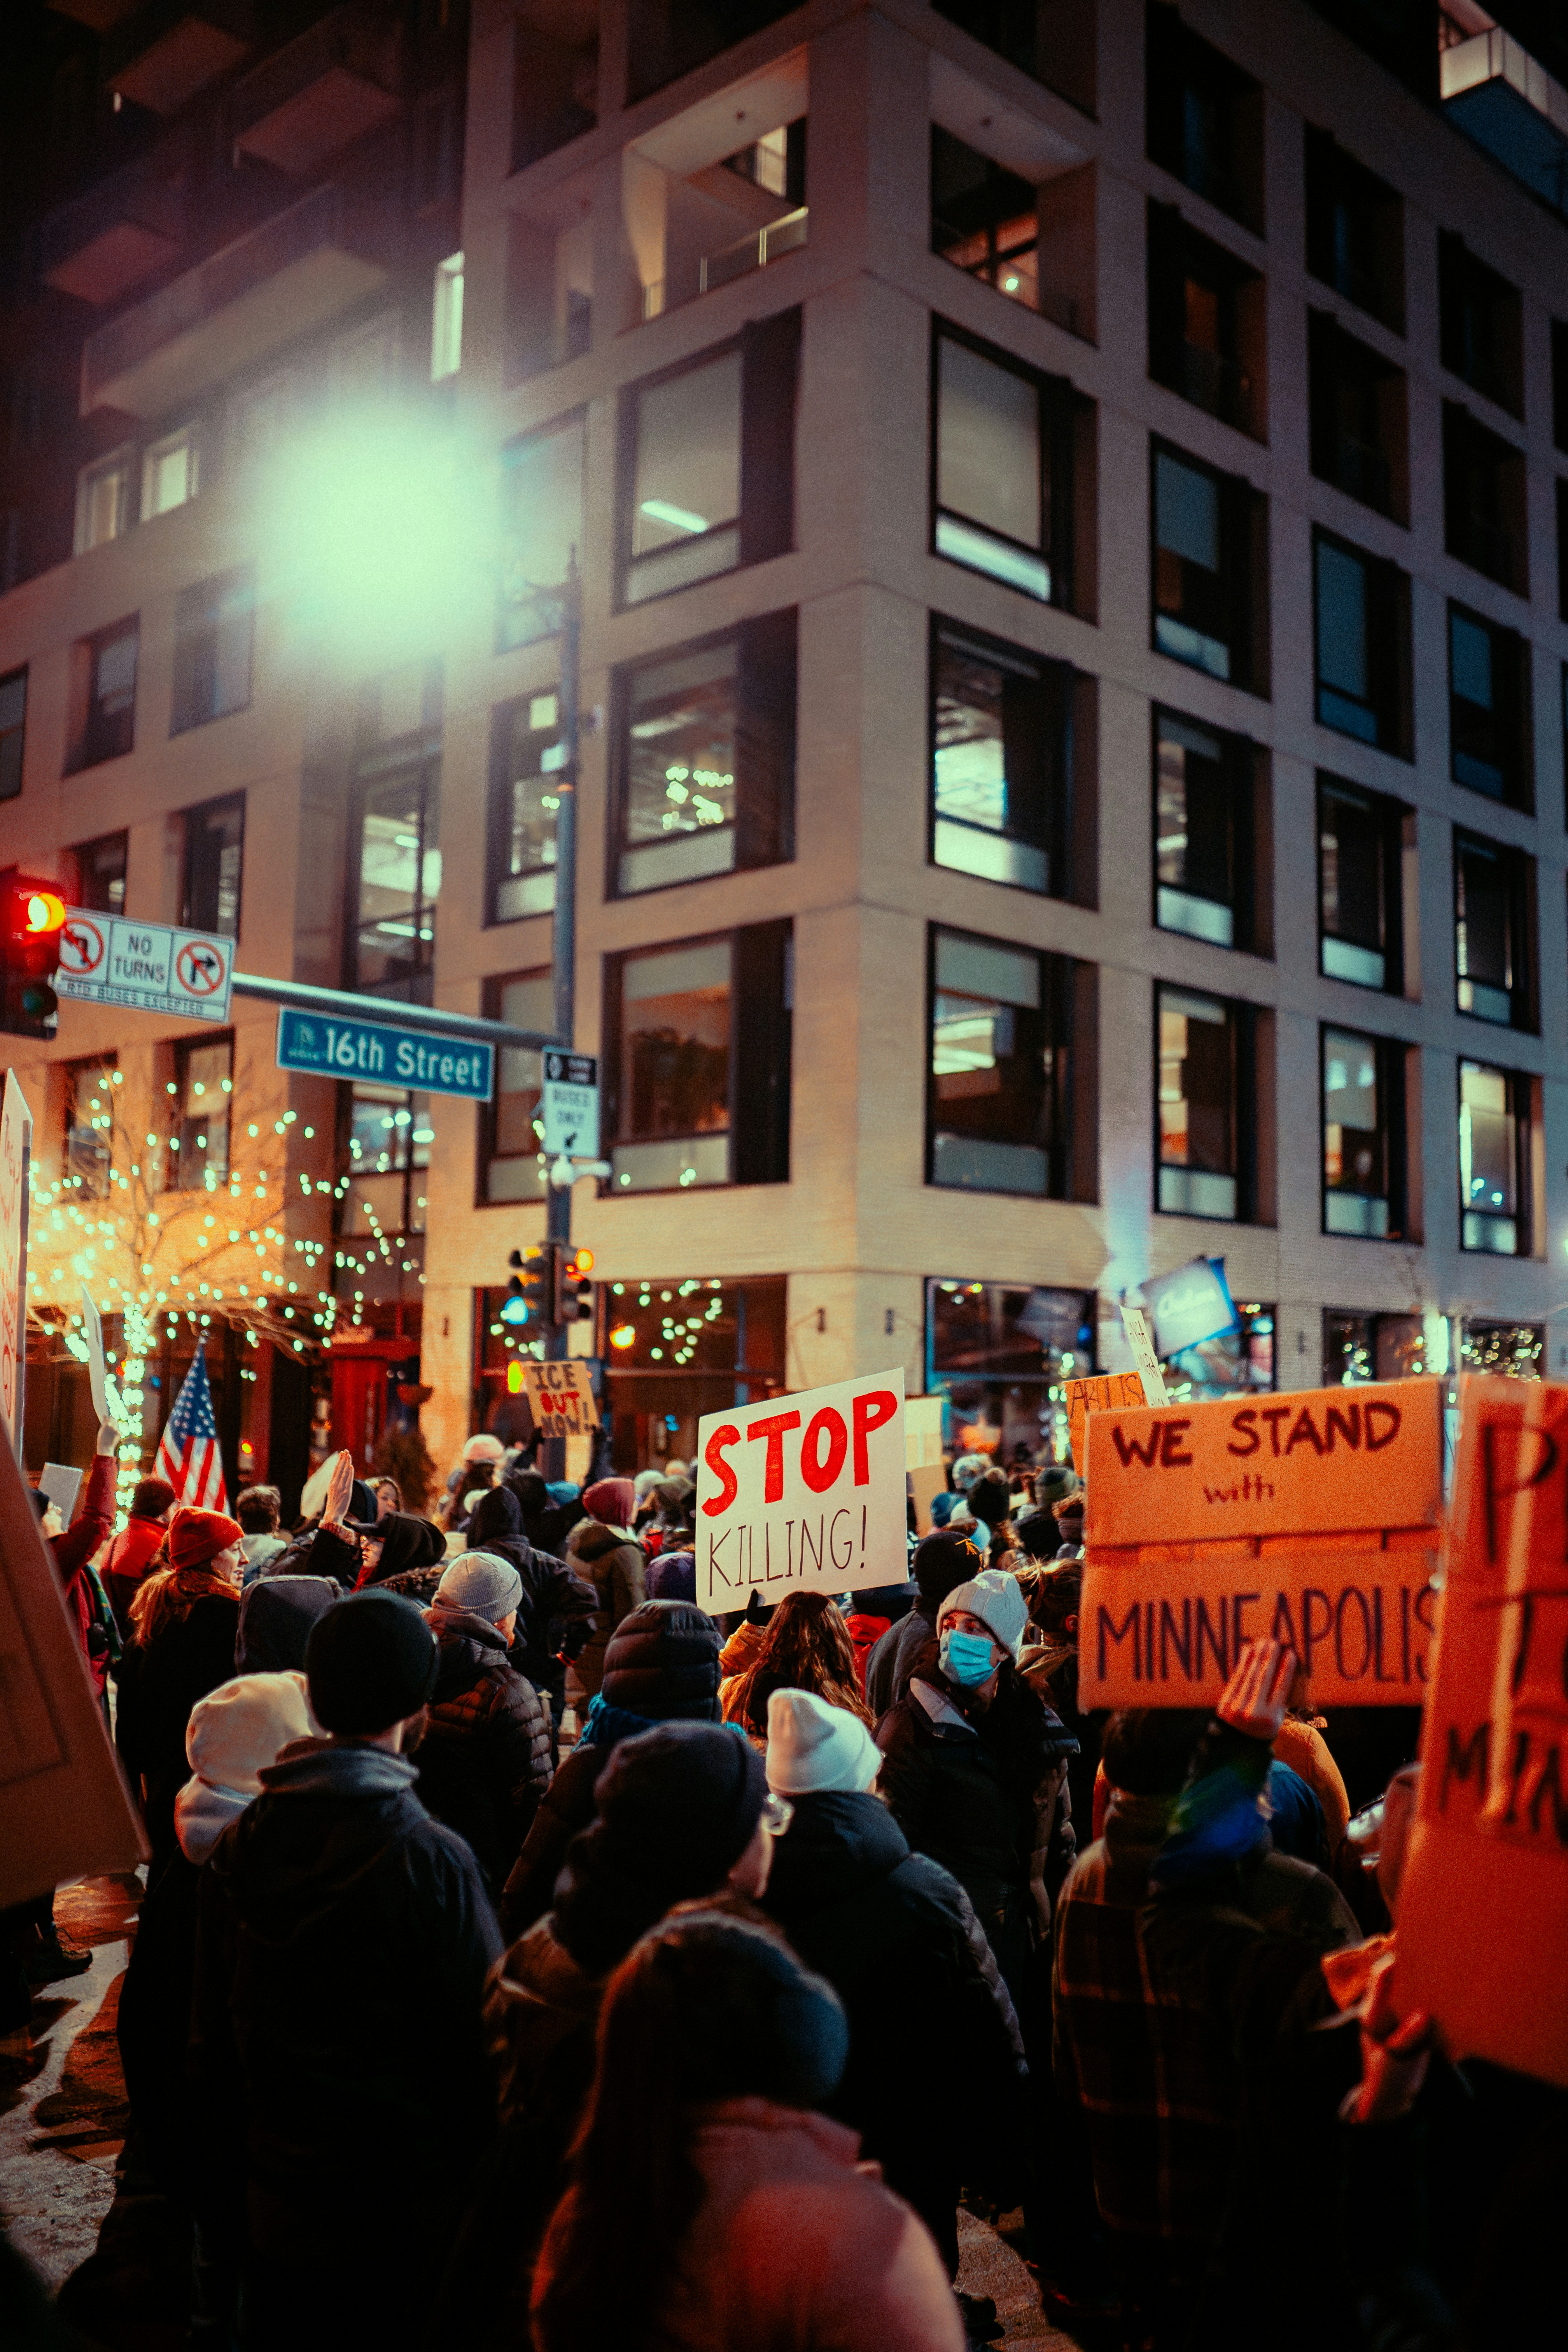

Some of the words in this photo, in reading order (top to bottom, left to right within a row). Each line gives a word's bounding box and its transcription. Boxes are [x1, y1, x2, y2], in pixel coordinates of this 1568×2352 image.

[128, 933, 152, 956] NO
[114, 956, 165, 984] TURNS
[97, 986, 138, 1004] BUSES
[326, 1027, 385, 1072] 16th
[396, 1040, 481, 1087] Street
[530, 1363, 578, 1391] ICE
[540, 1391, 580, 1420] OUT
[1111, 1418, 1193, 1468] WE
[1227, 1401, 1402, 1459] STAND
[701, 1390, 898, 1517] STOP
[1203, 1473, 1275, 1504] with
[709, 1505, 866, 1597] KILLING!
[1097, 1585, 1435, 1684] MINNEAPOLIS
